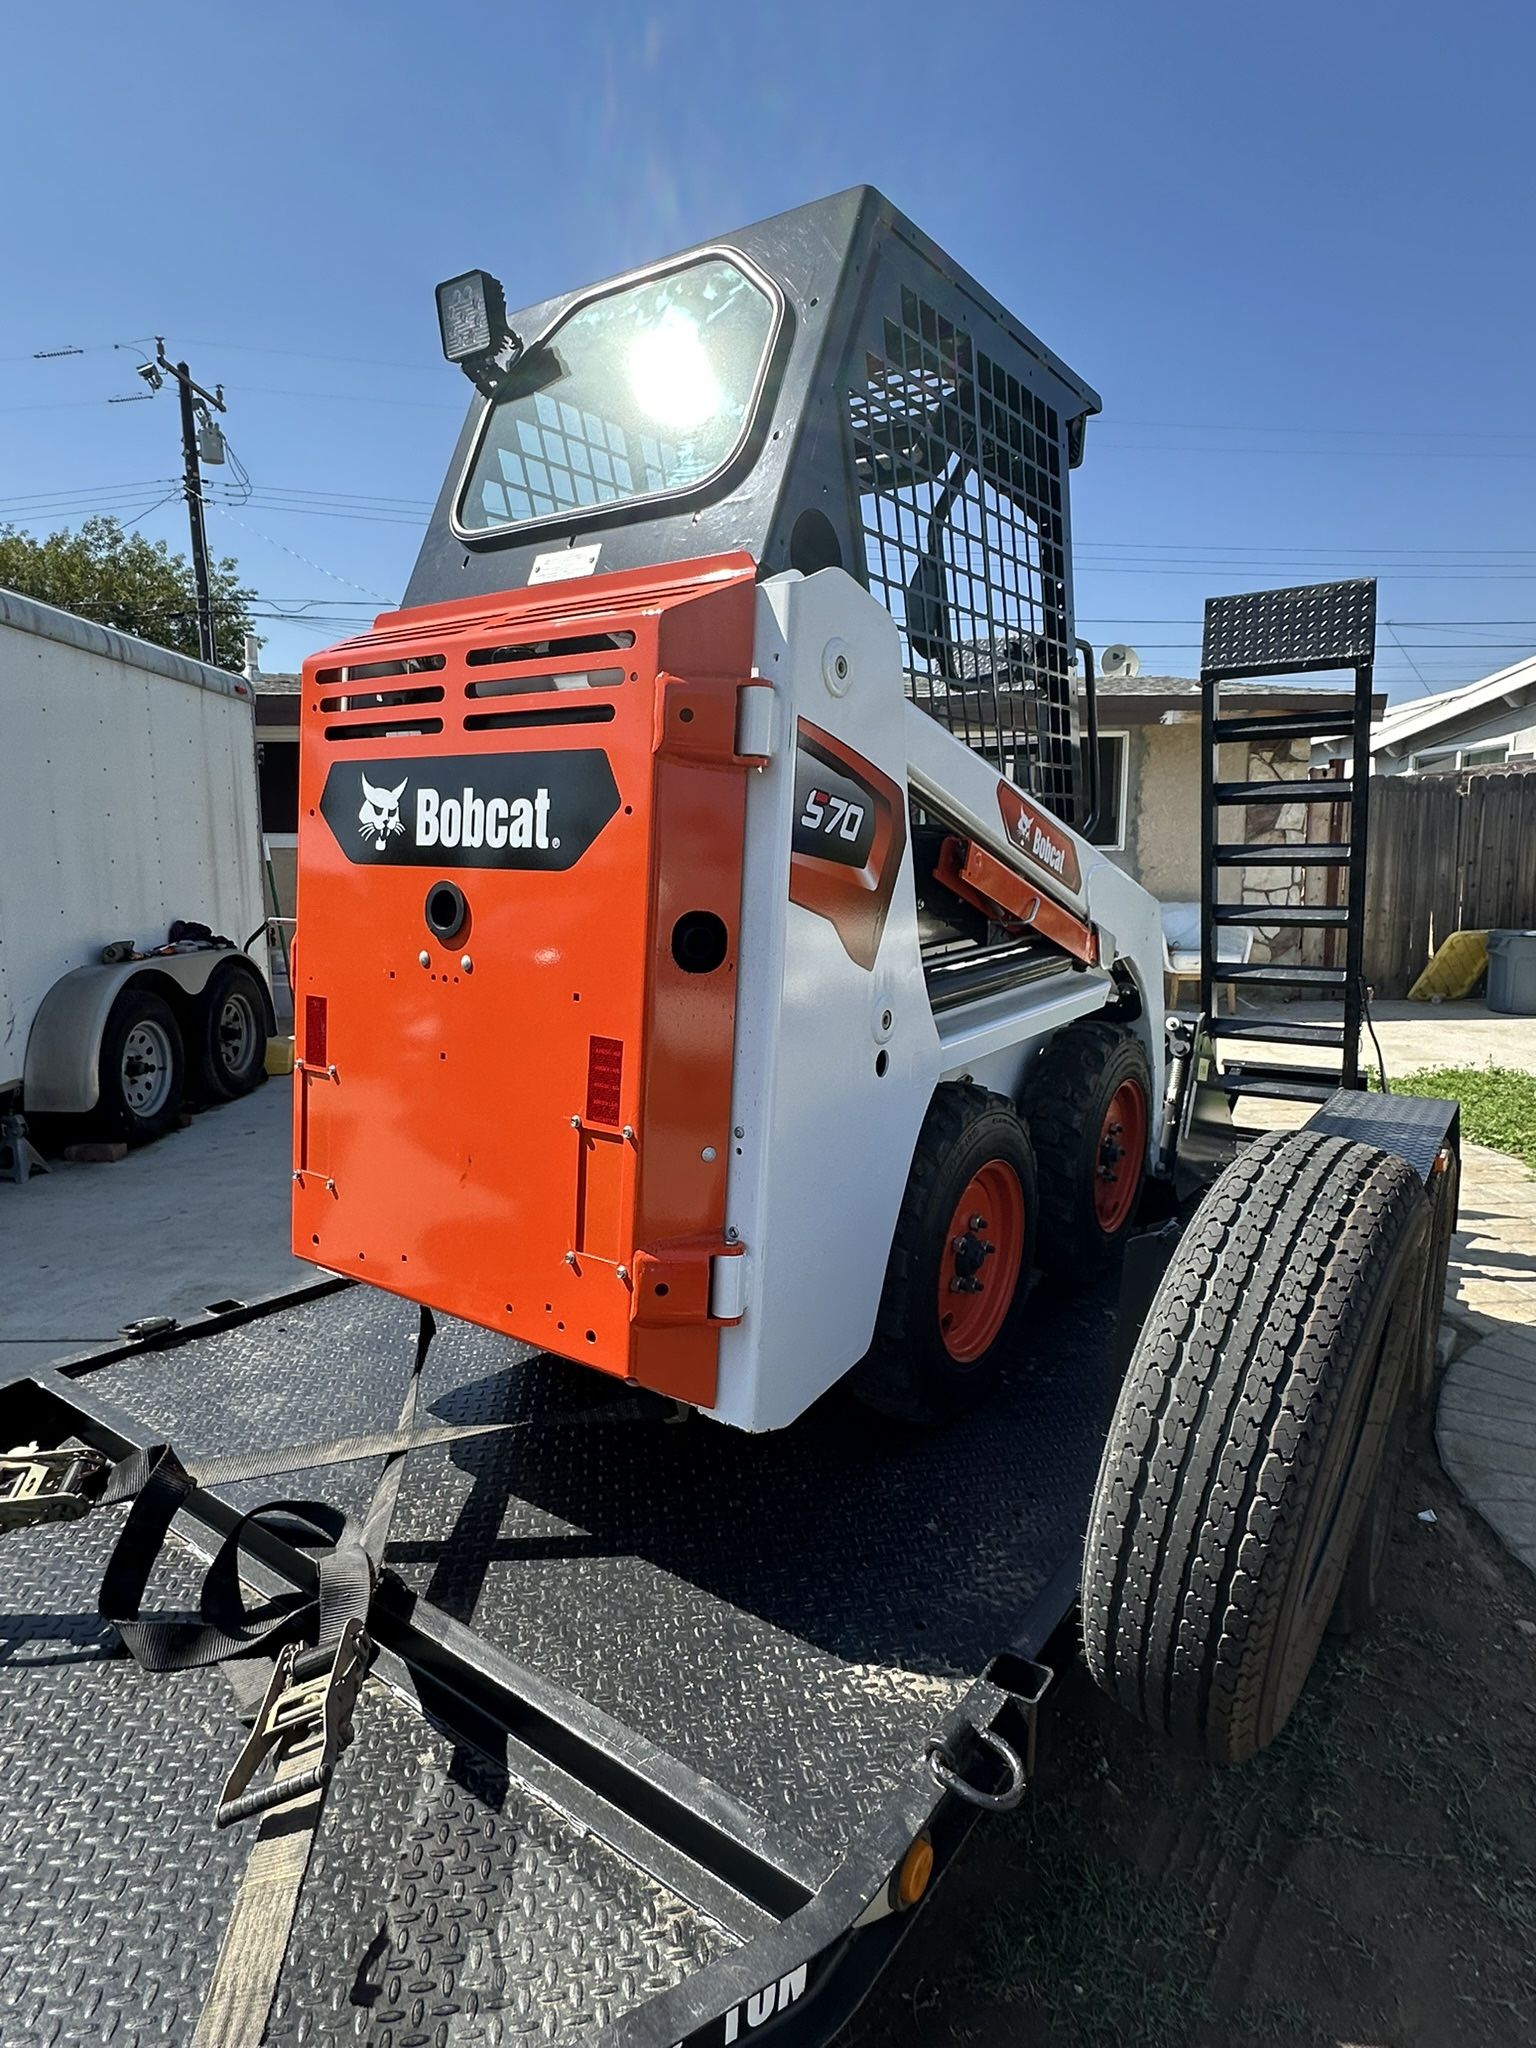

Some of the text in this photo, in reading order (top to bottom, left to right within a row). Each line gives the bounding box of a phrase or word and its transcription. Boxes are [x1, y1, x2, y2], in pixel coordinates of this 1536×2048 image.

[415, 787, 551, 849] Bobcat
[801, 789, 865, 842] S70
[1032, 826, 1066, 874] Bobcat
